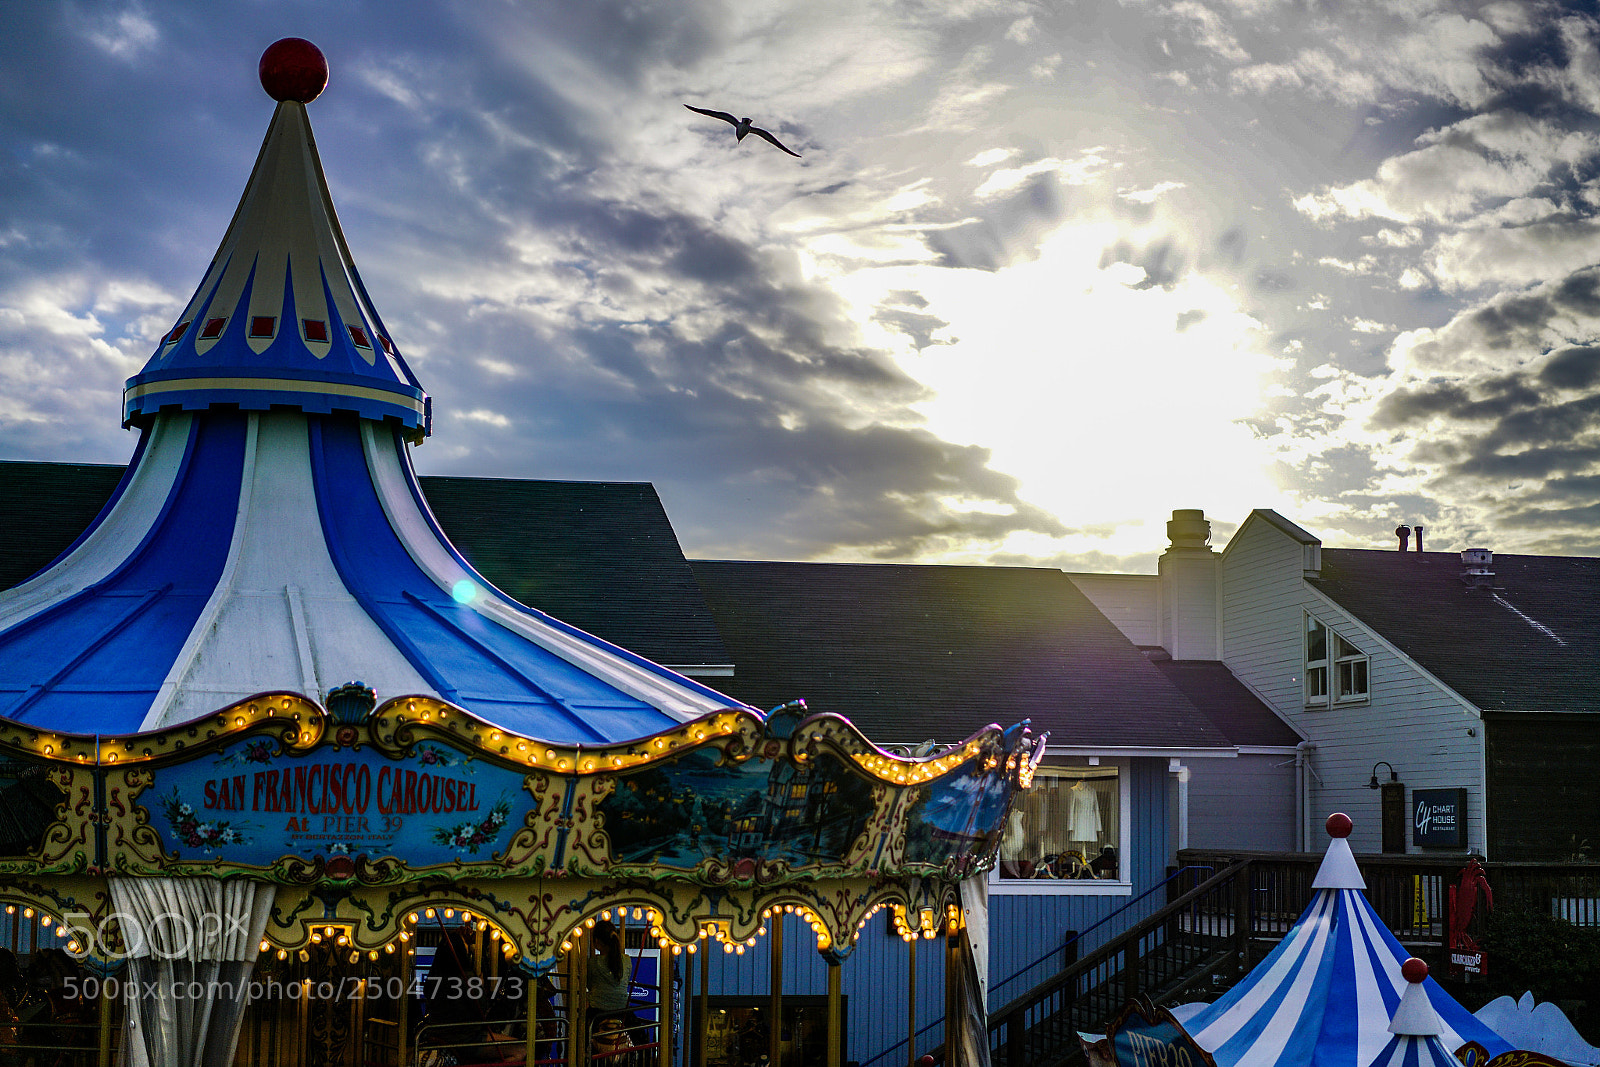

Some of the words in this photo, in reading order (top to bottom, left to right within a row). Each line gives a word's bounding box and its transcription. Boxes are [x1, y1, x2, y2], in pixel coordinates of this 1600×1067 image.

[203, 775, 246, 810] SAN
[251, 763, 370, 815] FRANCISCO
[376, 765, 480, 815] CAROUSEL
[1432, 805, 1456, 814] CHART
[285, 817, 310, 832] At
[322, 815, 371, 833] PIER
[380, 816, 403, 833] 39
[1432, 816, 1456, 824] HOUSE
[1126, 1031, 1170, 1067] PIER
